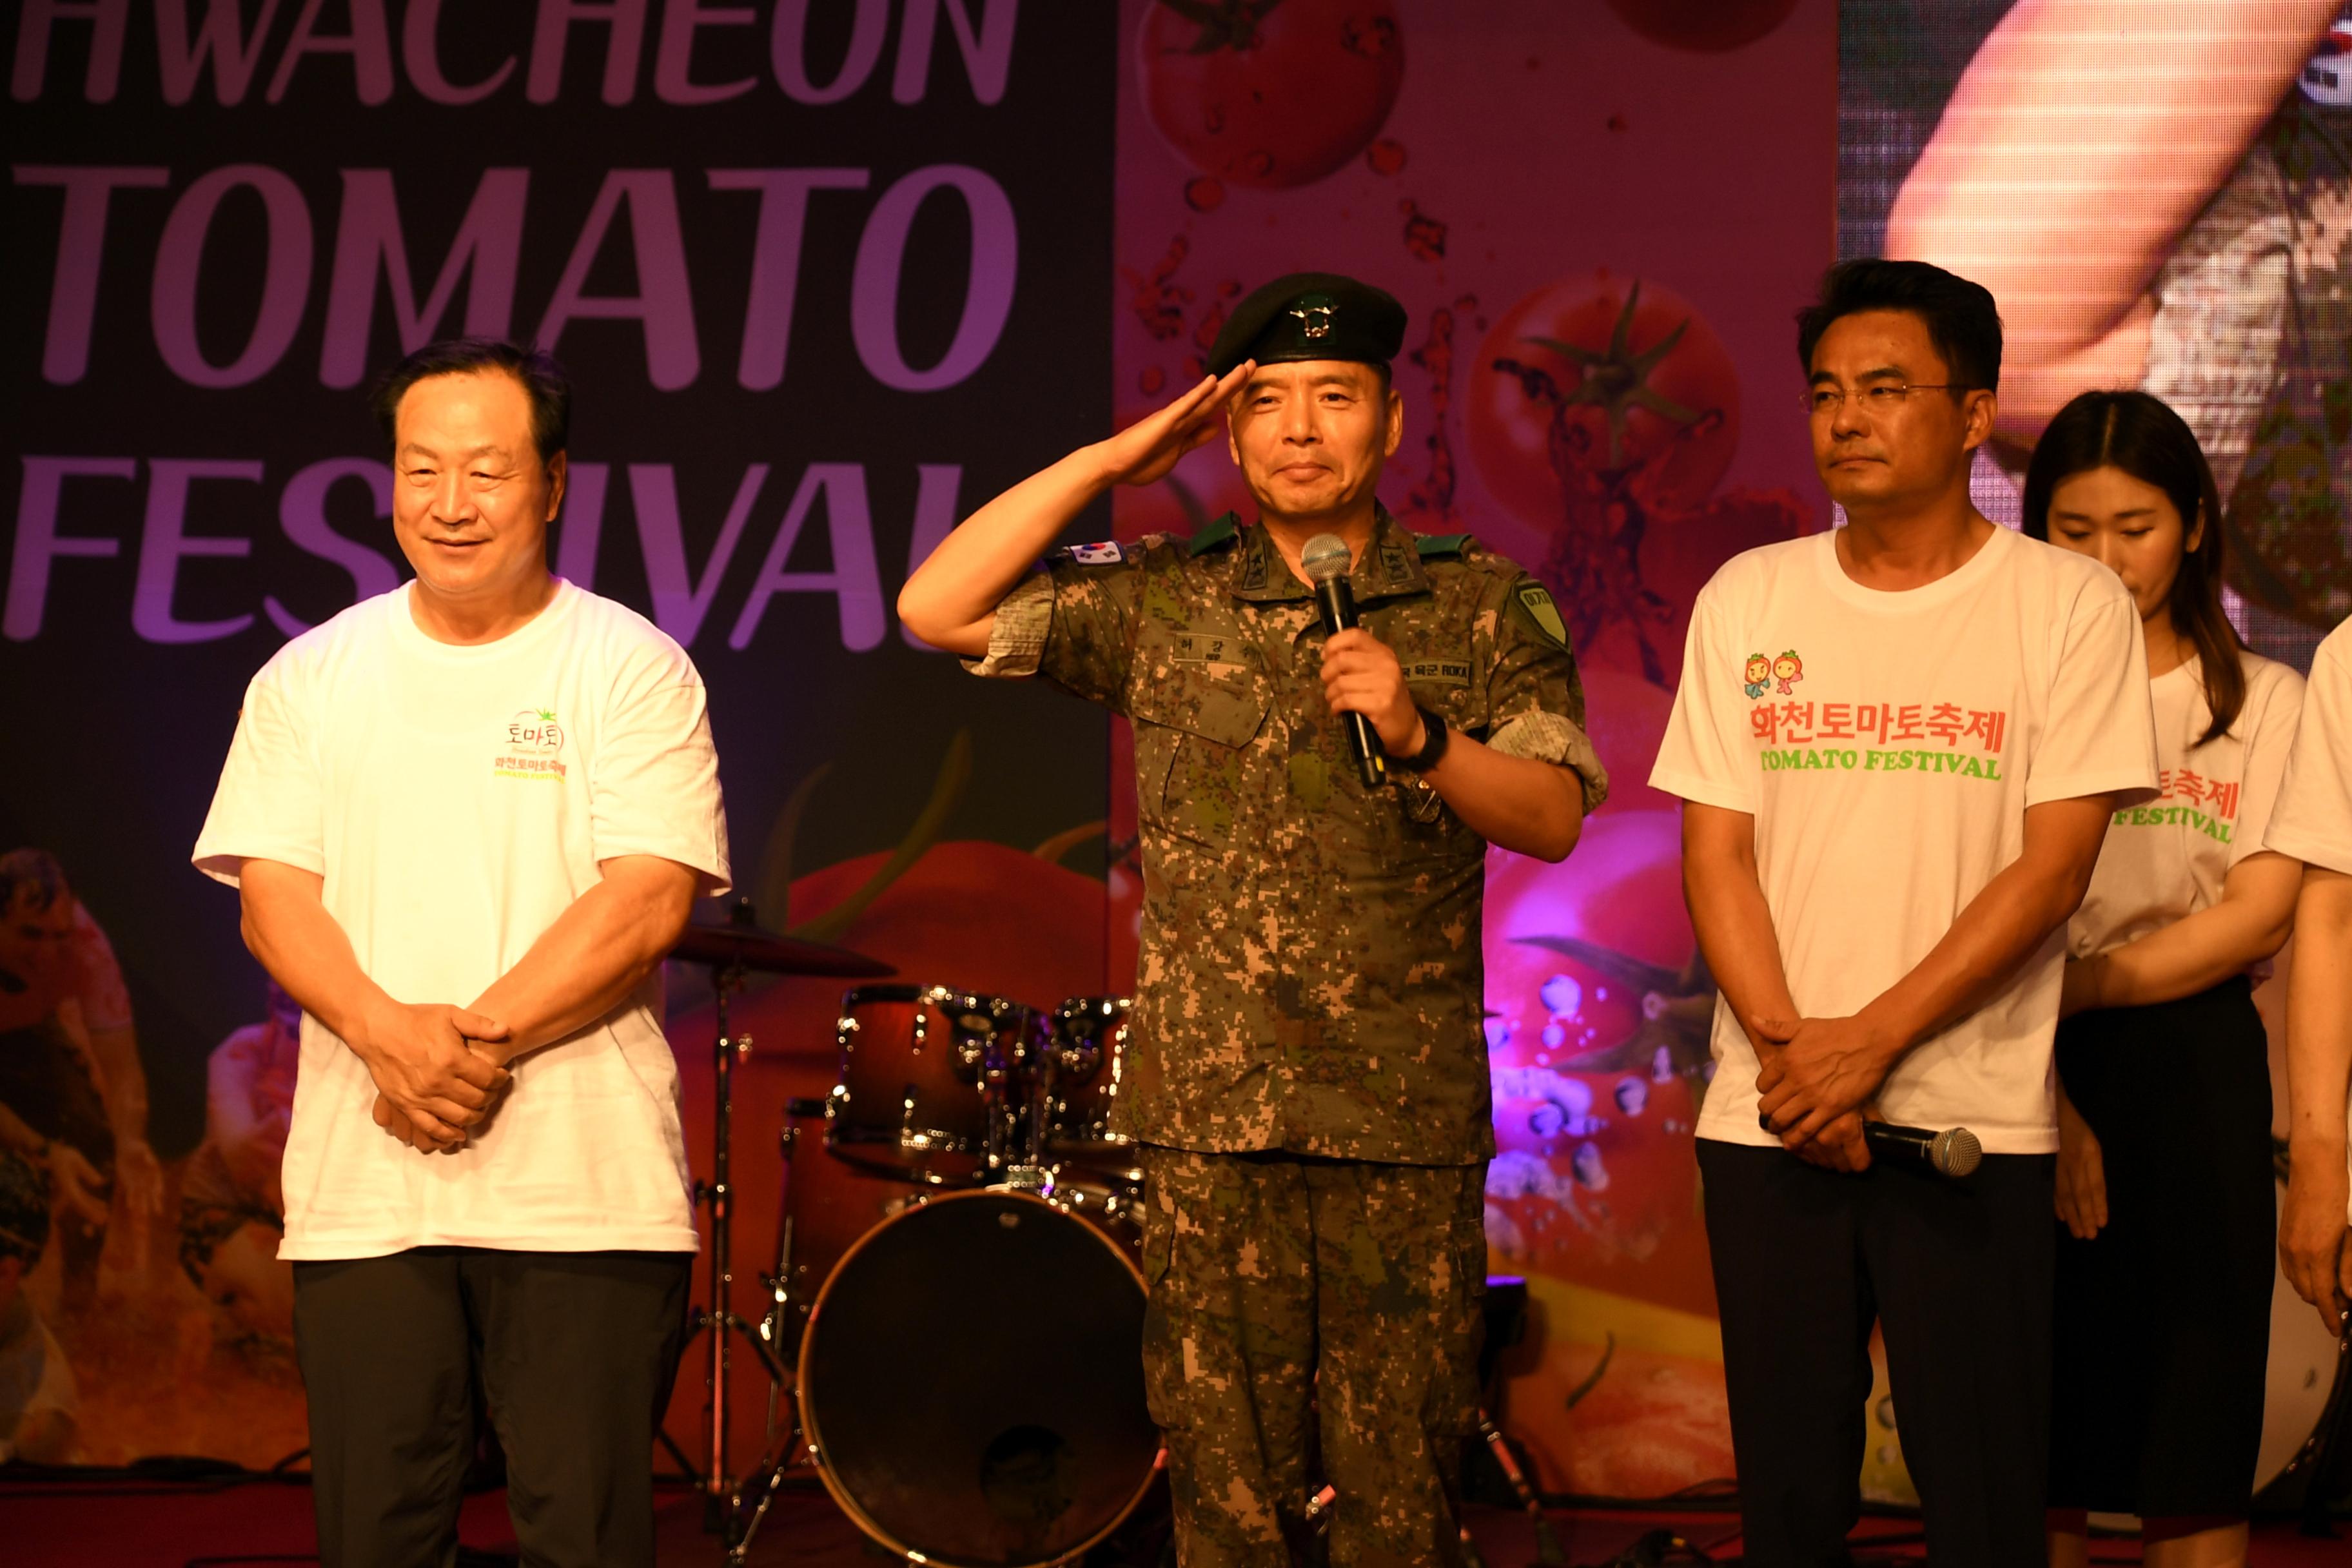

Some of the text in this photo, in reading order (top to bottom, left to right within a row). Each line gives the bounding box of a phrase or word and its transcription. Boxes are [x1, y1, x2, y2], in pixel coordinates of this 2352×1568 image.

[10, 0, 1018, 107] HWACHEON
[11, 163, 1019, 393] TOMATO
[2, 455, 963, 653] FESIVA
[1442, 664, 1467, 678] ROKA
[505, 723, 556, 746] 토마토
[1750, 701, 2006, 753] 화천토마토축제
[1761, 749, 2002, 781] TOMATO FESTIVAL
[2113, 807, 2232, 844] FESTIVAL
